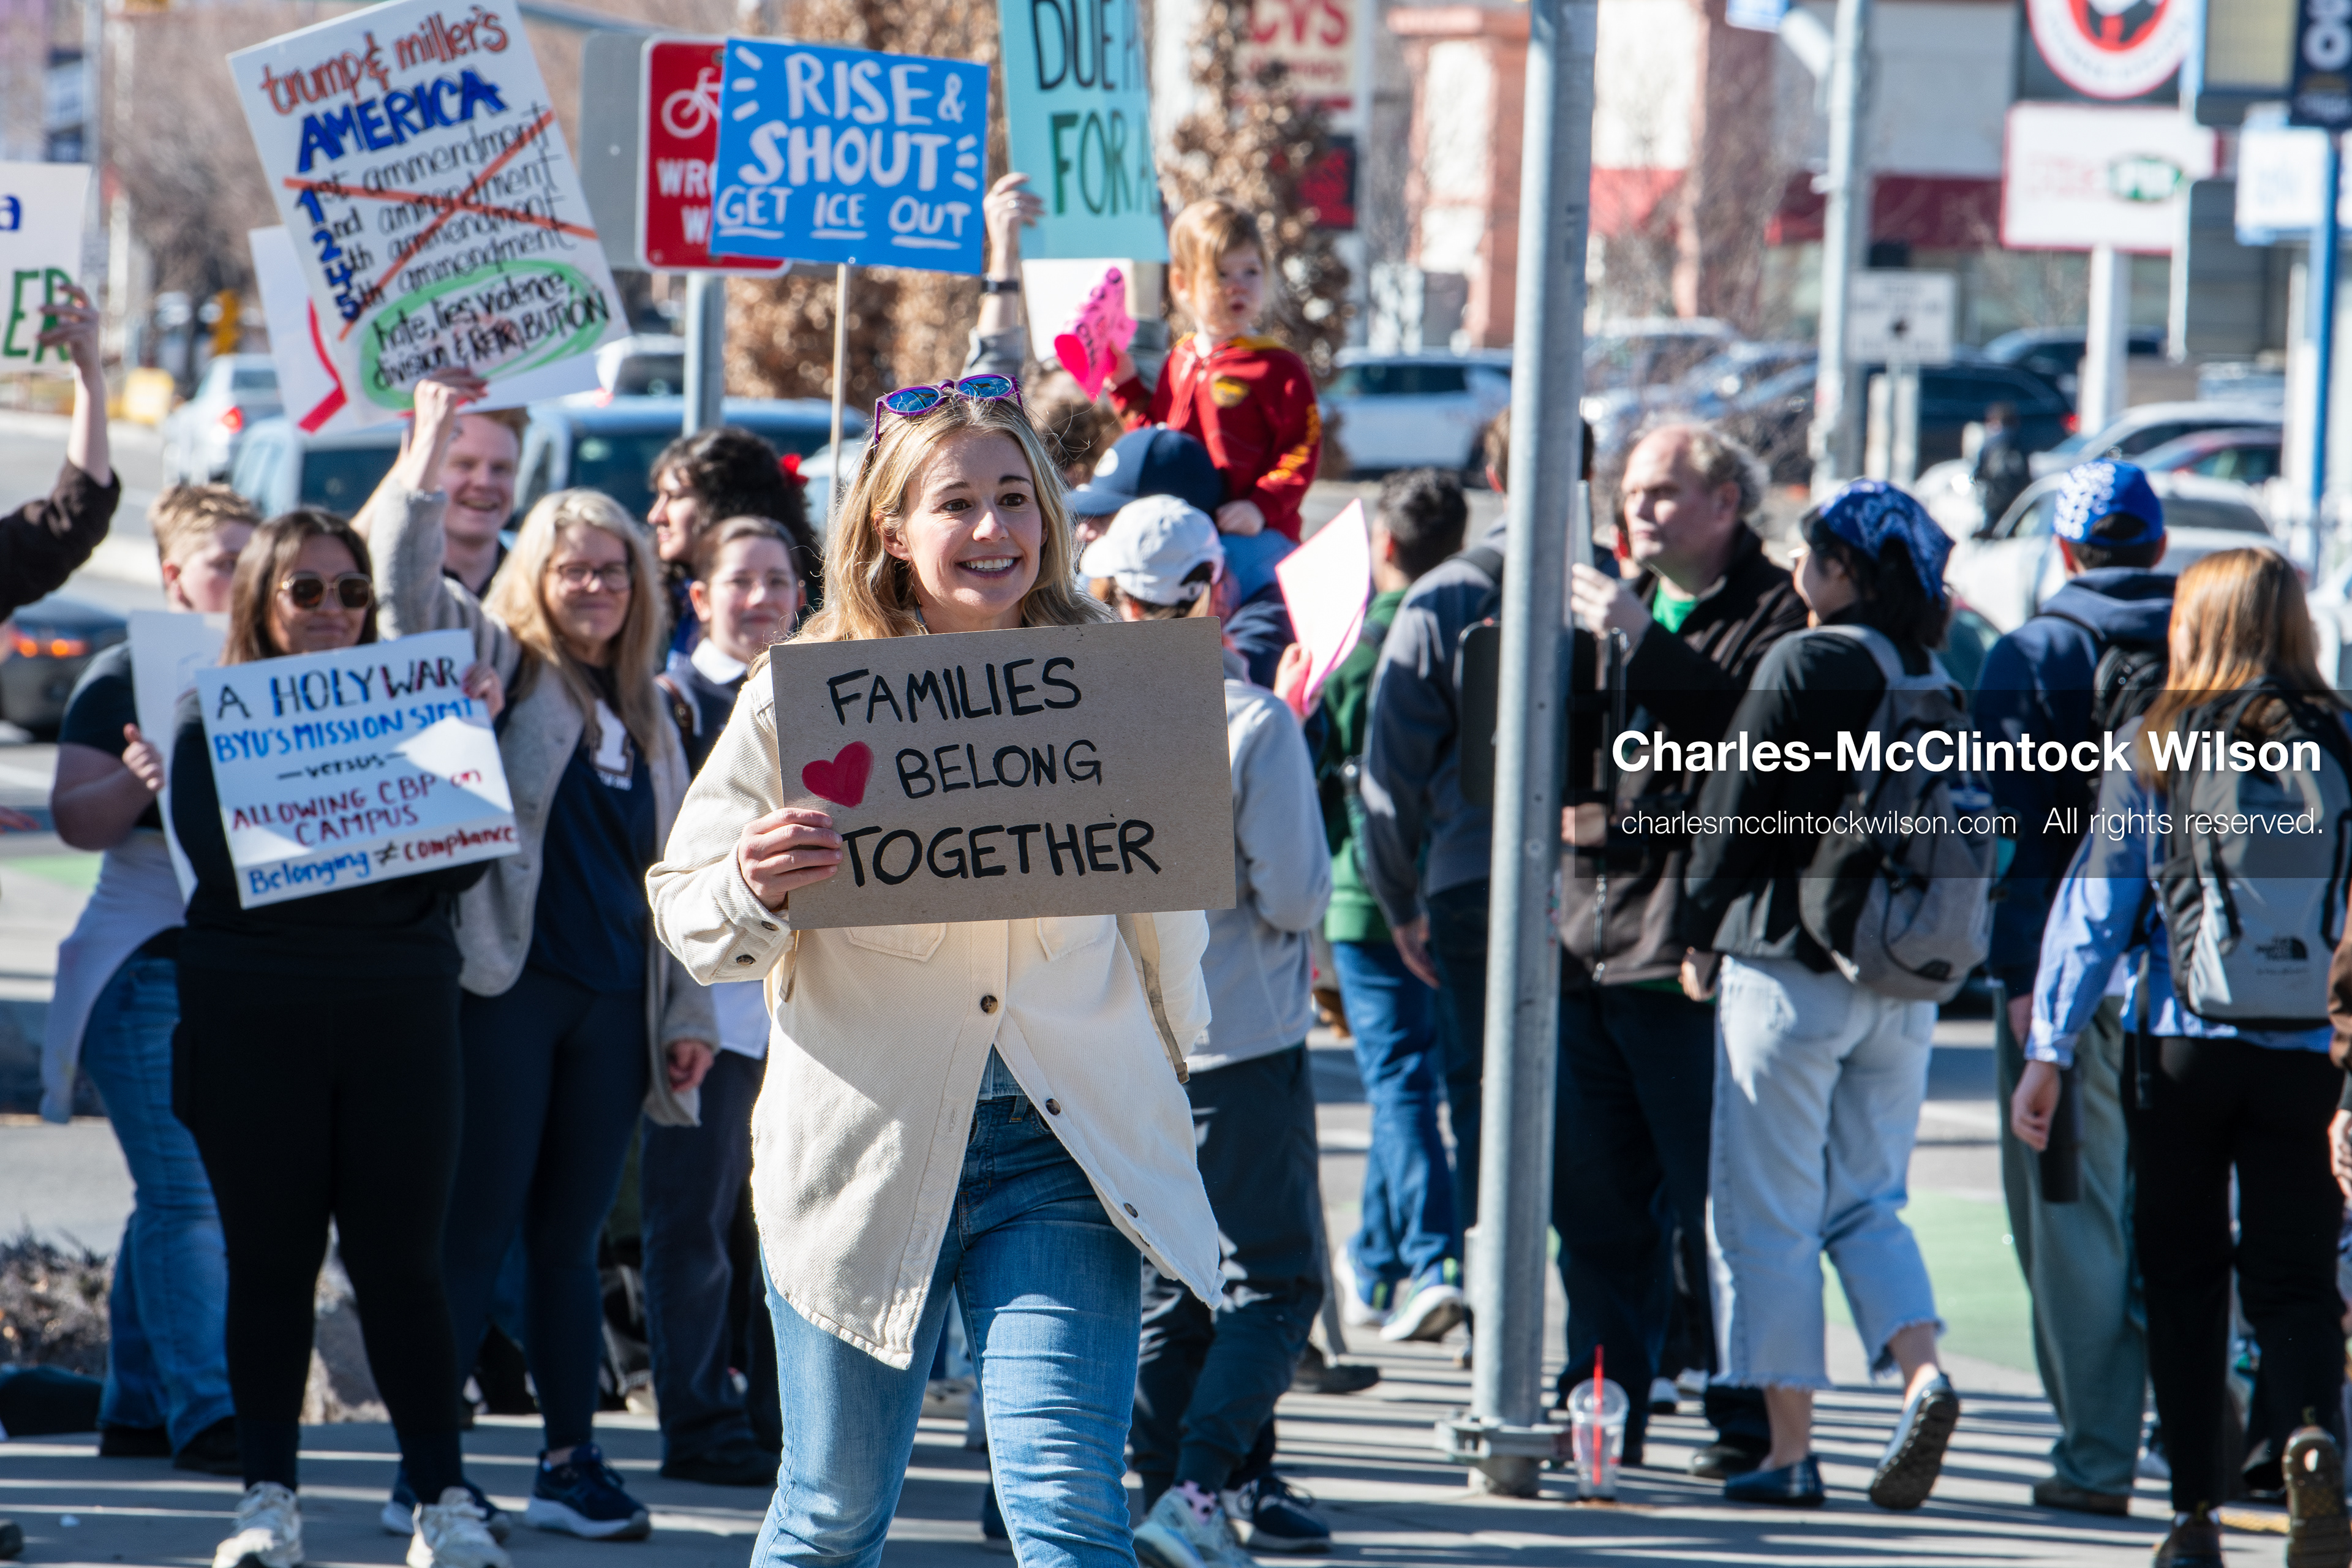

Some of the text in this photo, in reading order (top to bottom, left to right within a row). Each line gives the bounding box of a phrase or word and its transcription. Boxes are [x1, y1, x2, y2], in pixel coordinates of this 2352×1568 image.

[260, 6, 509, 115] trump & miller's
[785, 52, 967, 126] RISE &
[298, 67, 510, 173] AMERICA
[737, 119, 952, 192] SHOUT
[716, 185, 972, 238] GET ICE OUT
[216, 655, 459, 720] A HOLY WAR
[827, 657, 1082, 725] FAMILIES
[292, 709, 404, 751] MISSION
[895, 739, 1102, 799] BELONG
[232, 788, 368, 831] ALLOWING
[378, 774, 437, 805] CBP
[295, 803, 419, 848] CAMPUS
[249, 850, 371, 895] Belonging
[841, 819, 1161, 888] TOGETHER
